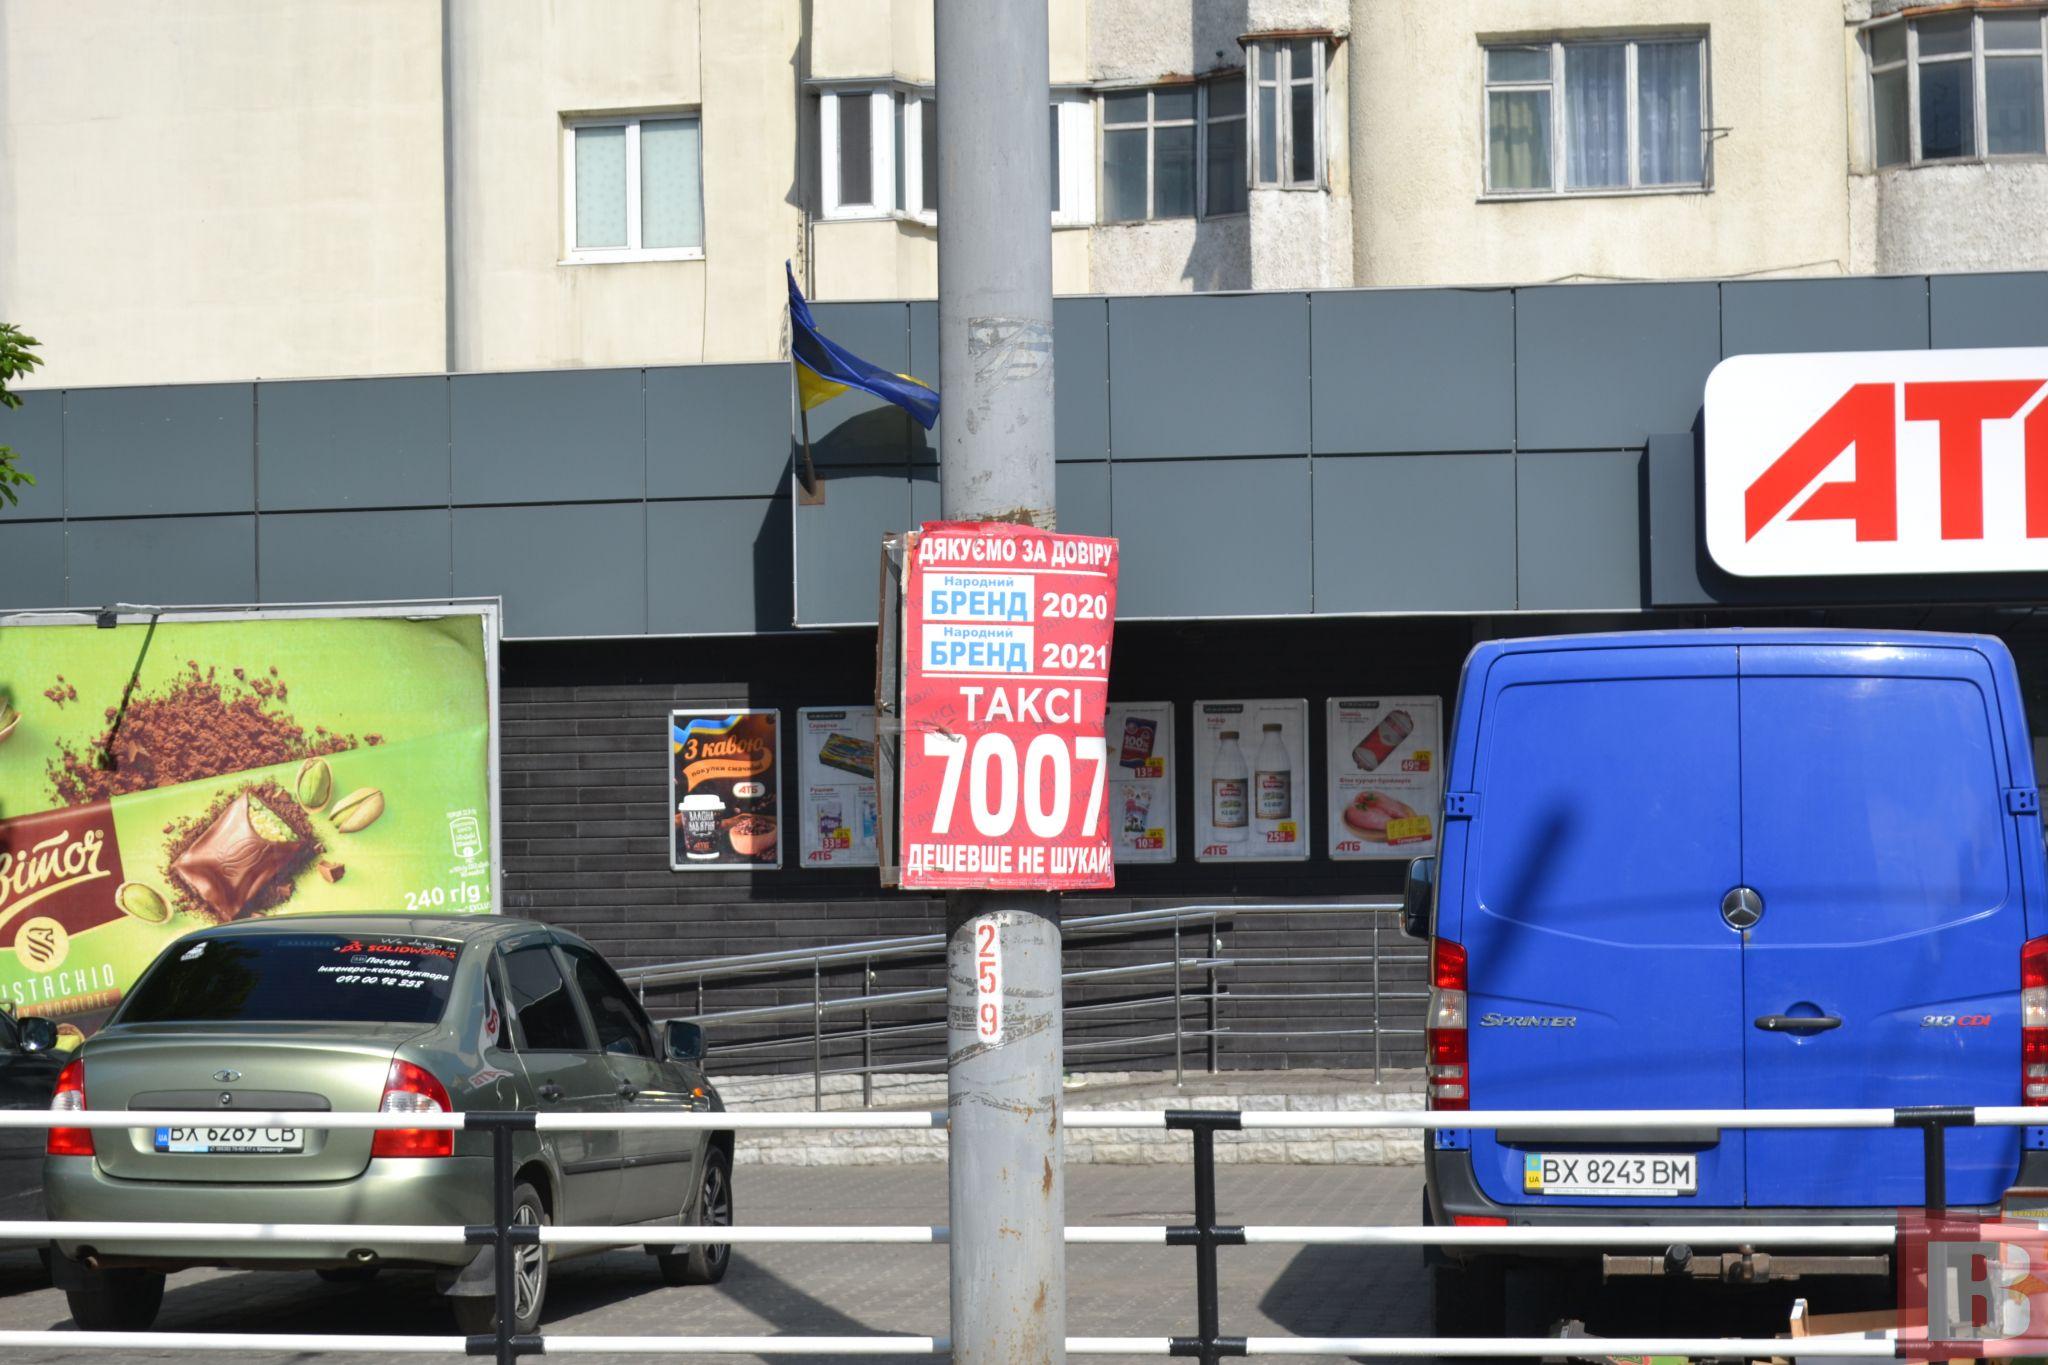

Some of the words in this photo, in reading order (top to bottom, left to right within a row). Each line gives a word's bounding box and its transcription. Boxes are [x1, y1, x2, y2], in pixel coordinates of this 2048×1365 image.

[1744, 378, 2048, 543] АТ
[918, 536, 1016, 565] ДЯКУЄМО
[1021, 539, 1046, 562] ЗА
[1051, 541, 1113, 567] ДОВІРУ
[944, 575, 1014, 588] Народний
[931, 590, 1028, 621] БРЕНД
[1042, 592, 1108, 620] 2020
[943, 626, 1013, 639] Народний
[930, 641, 1027, 672] БРЕНД
[1041, 643, 1107, 670] 2021
[959, 686, 1082, 724] ТАКСІ
[923, 732, 1108, 839] 7007
[808, 849, 833, 860] АТБ
[907, 843, 1012, 876] ДЕШЕВШЕ
[1018, 846, 1044, 873] НЕ
[1203, 845, 1229, 855] АТБ
[1336, 842, 1361, 852] АТБ
[404, 886, 445, 911] 240
[365, 957, 411, 967] Послуги
[367, 944, 457, 960] SOLIDWORKS
[978, 924, 998, 1036] 259
[1528, 1176, 1540, 1184] UA
[1543, 1159, 1579, 1184] BX
[1587, 1160, 1645, 1184] 8243
[1652, 1161, 1690, 1185] BM
